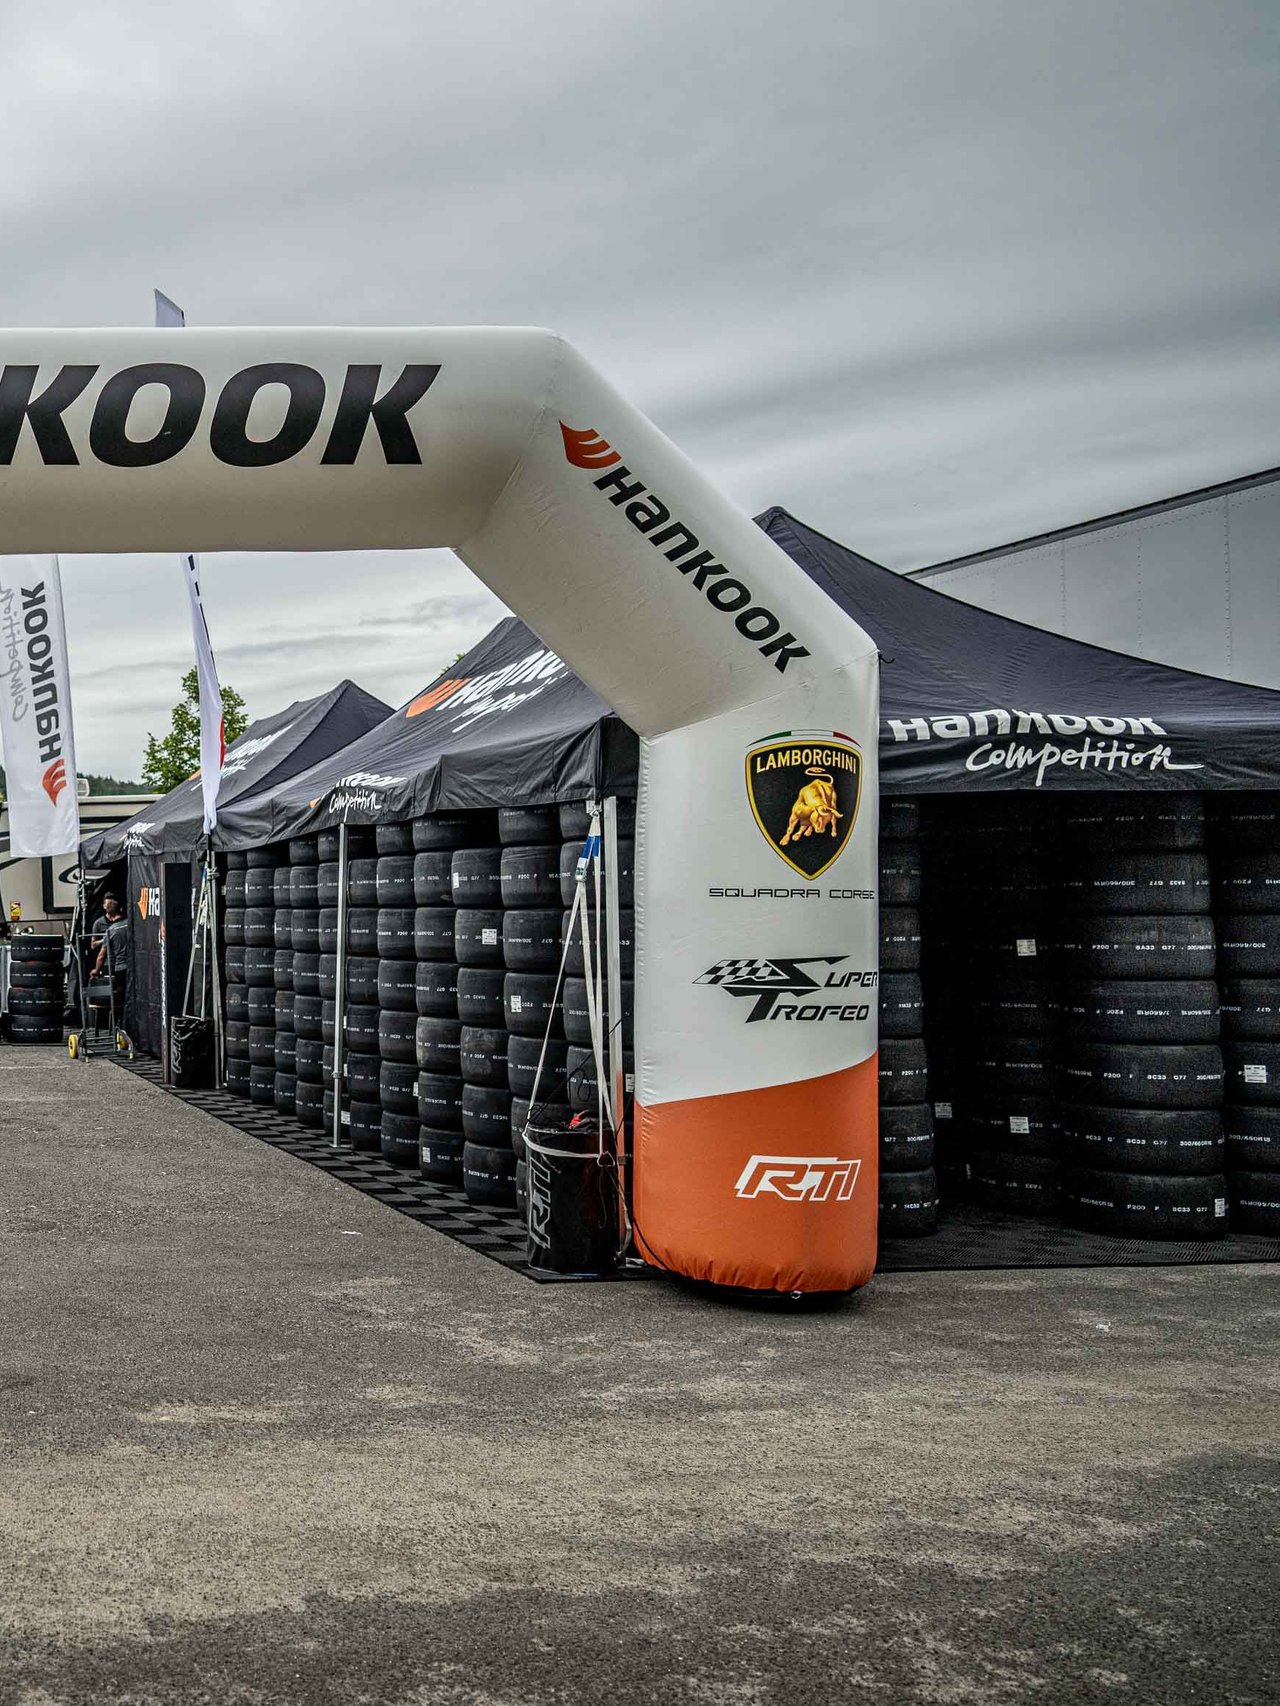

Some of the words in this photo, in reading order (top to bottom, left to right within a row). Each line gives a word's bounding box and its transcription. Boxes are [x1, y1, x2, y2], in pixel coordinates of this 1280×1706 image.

[592, 465, 811, 674] HANKOOK
[755, 747, 859, 776] LAMBORGHINI
[709, 887, 820, 899] SQUADRA
[829, 889, 875, 900] CORSE
[734, 1154, 862, 1202] RTI
